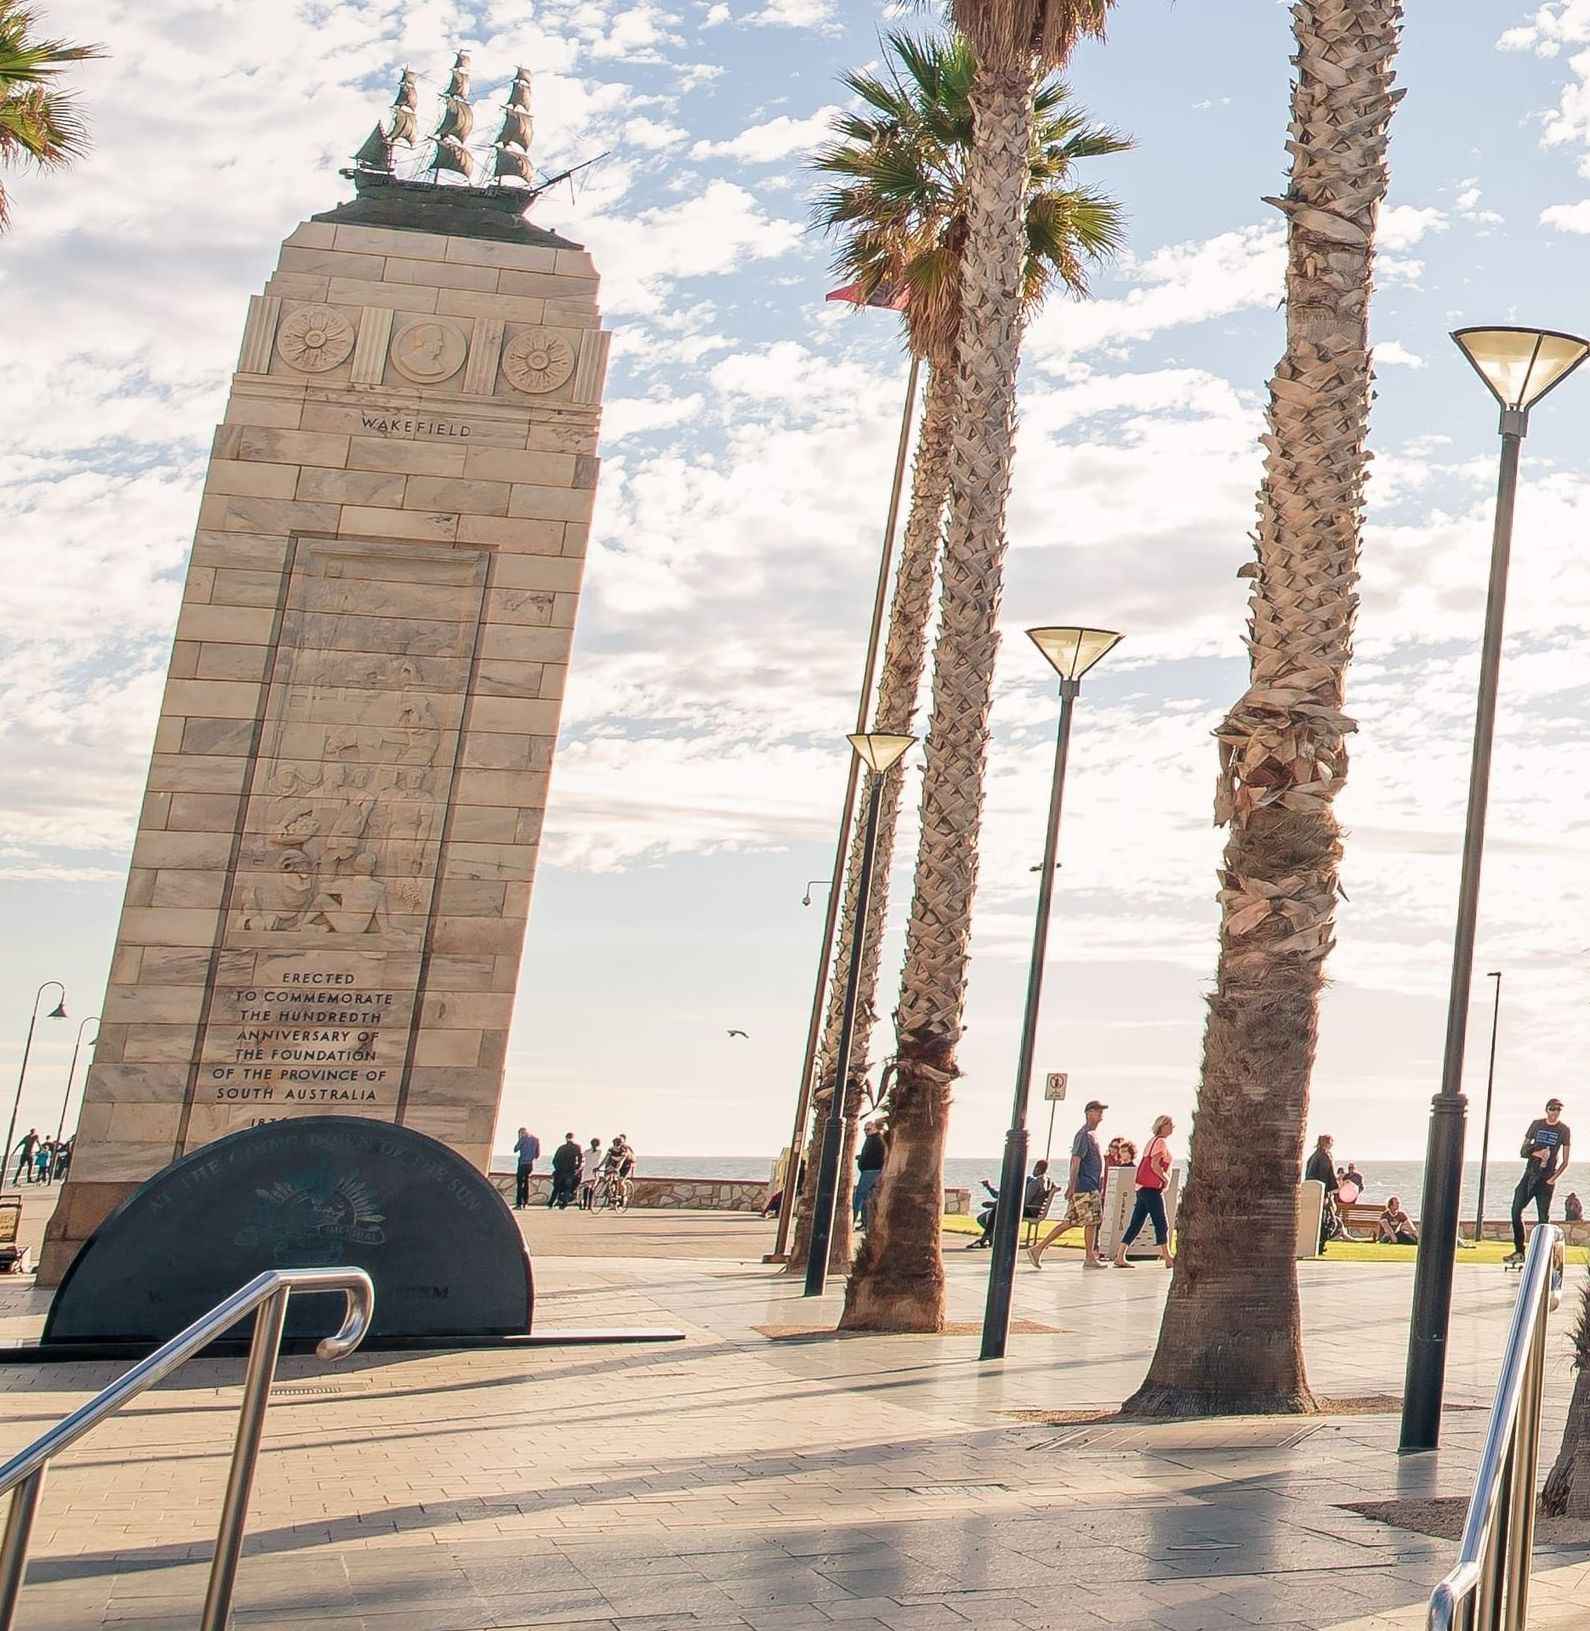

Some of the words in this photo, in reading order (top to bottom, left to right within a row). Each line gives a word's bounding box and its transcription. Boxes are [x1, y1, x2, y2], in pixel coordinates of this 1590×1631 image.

[362, 416, 471, 437] WAKEFIELD
[282, 973, 355, 984] ERECTED
[236, 991, 257, 1002] TO
[264, 991, 393, 1005] COMMEMORATE
[241, 1010, 271, 1021] THE
[279, 1011, 381, 1023] HUNDREDTH
[236, 1030, 350, 1042] ANNIVERSARY
[357, 1031, 379, 1042] OF
[235, 1049, 264, 1060] THE
[271, 1049, 376, 1061] FOUNDATION
[212, 1068, 235, 1079] OF
[243, 1068, 272, 1080] THE
[280, 1069, 358, 1081] PROVINCE
[365, 1070, 387, 1081] OF
[216, 1088, 274, 1099] SOUTH
[284, 1089, 377, 1101] AUSTRALIA
[446, 1177, 482, 1212] SUN
